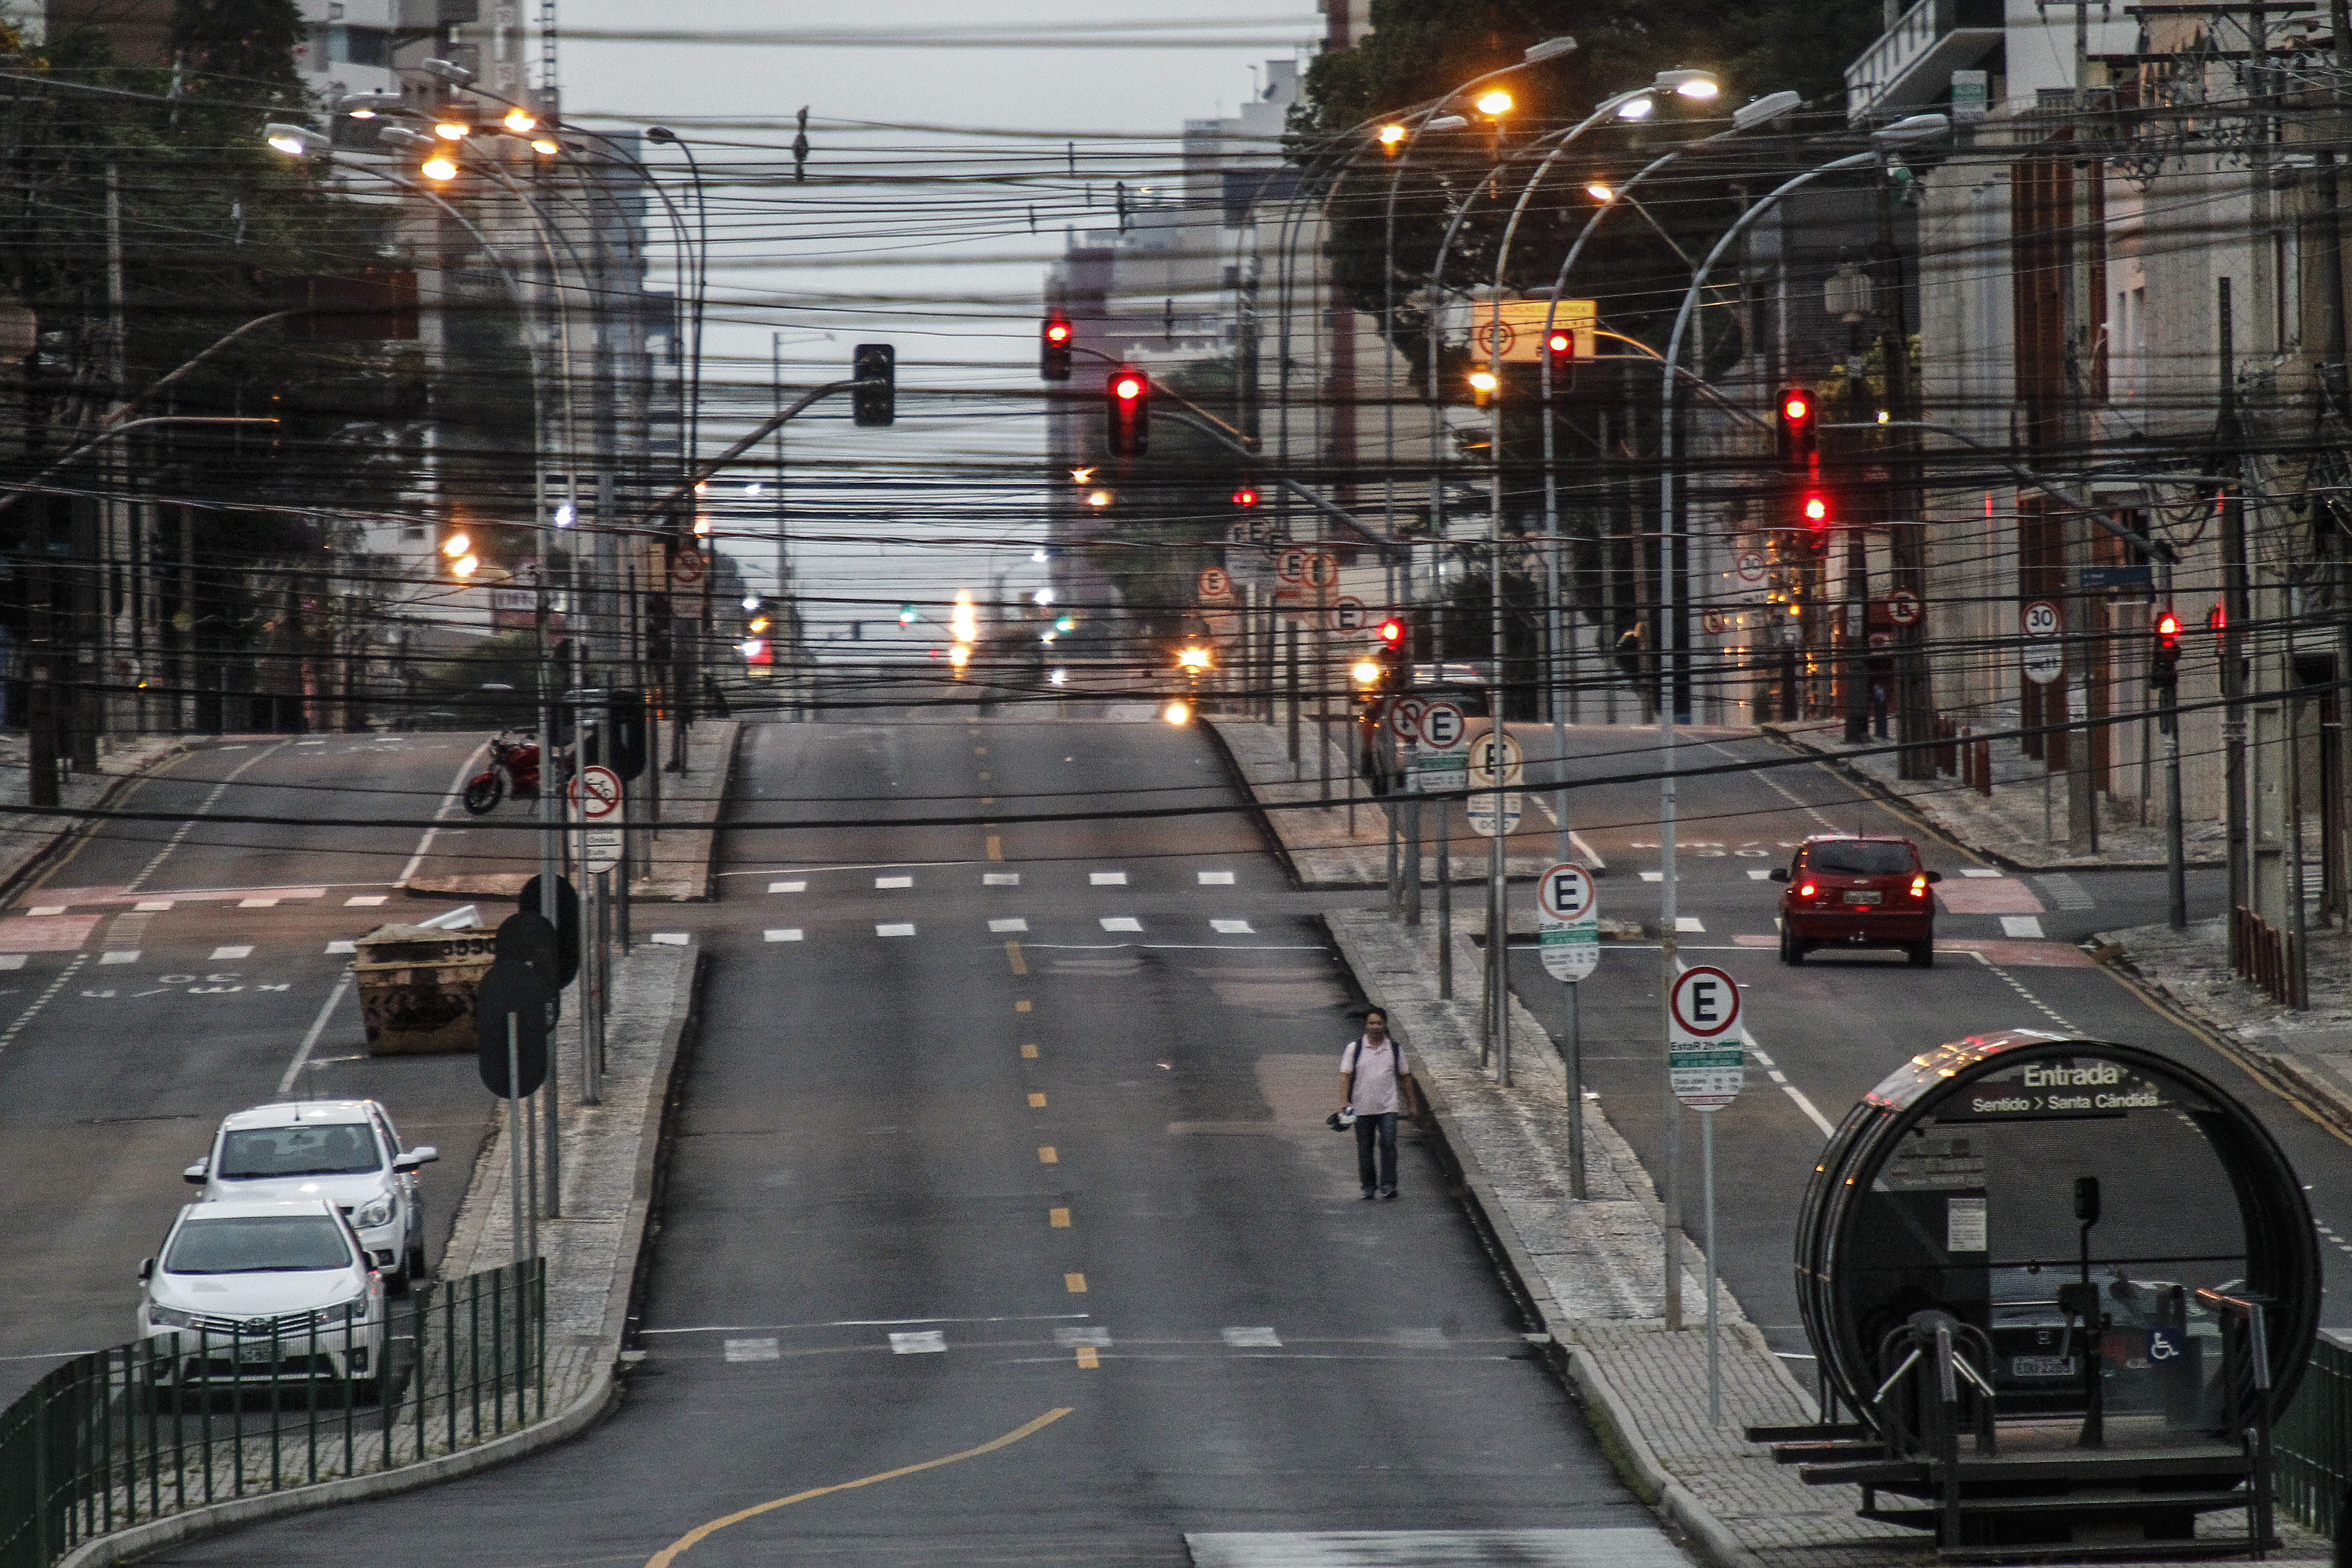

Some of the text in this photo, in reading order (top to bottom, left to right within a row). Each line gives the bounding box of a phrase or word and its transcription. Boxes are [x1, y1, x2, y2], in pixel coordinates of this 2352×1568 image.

[2030, 609, 2053, 626] 30
[1433, 711, 1452, 741] E
[1555, 875, 1579, 910] E
[1693, 982, 1718, 1022] E
[1671, 1041, 1701, 1051] EstaR
[2023, 1062, 2119, 1087] Entrada
[1973, 1093, 2159, 1112] Sentido Santa Cândida
